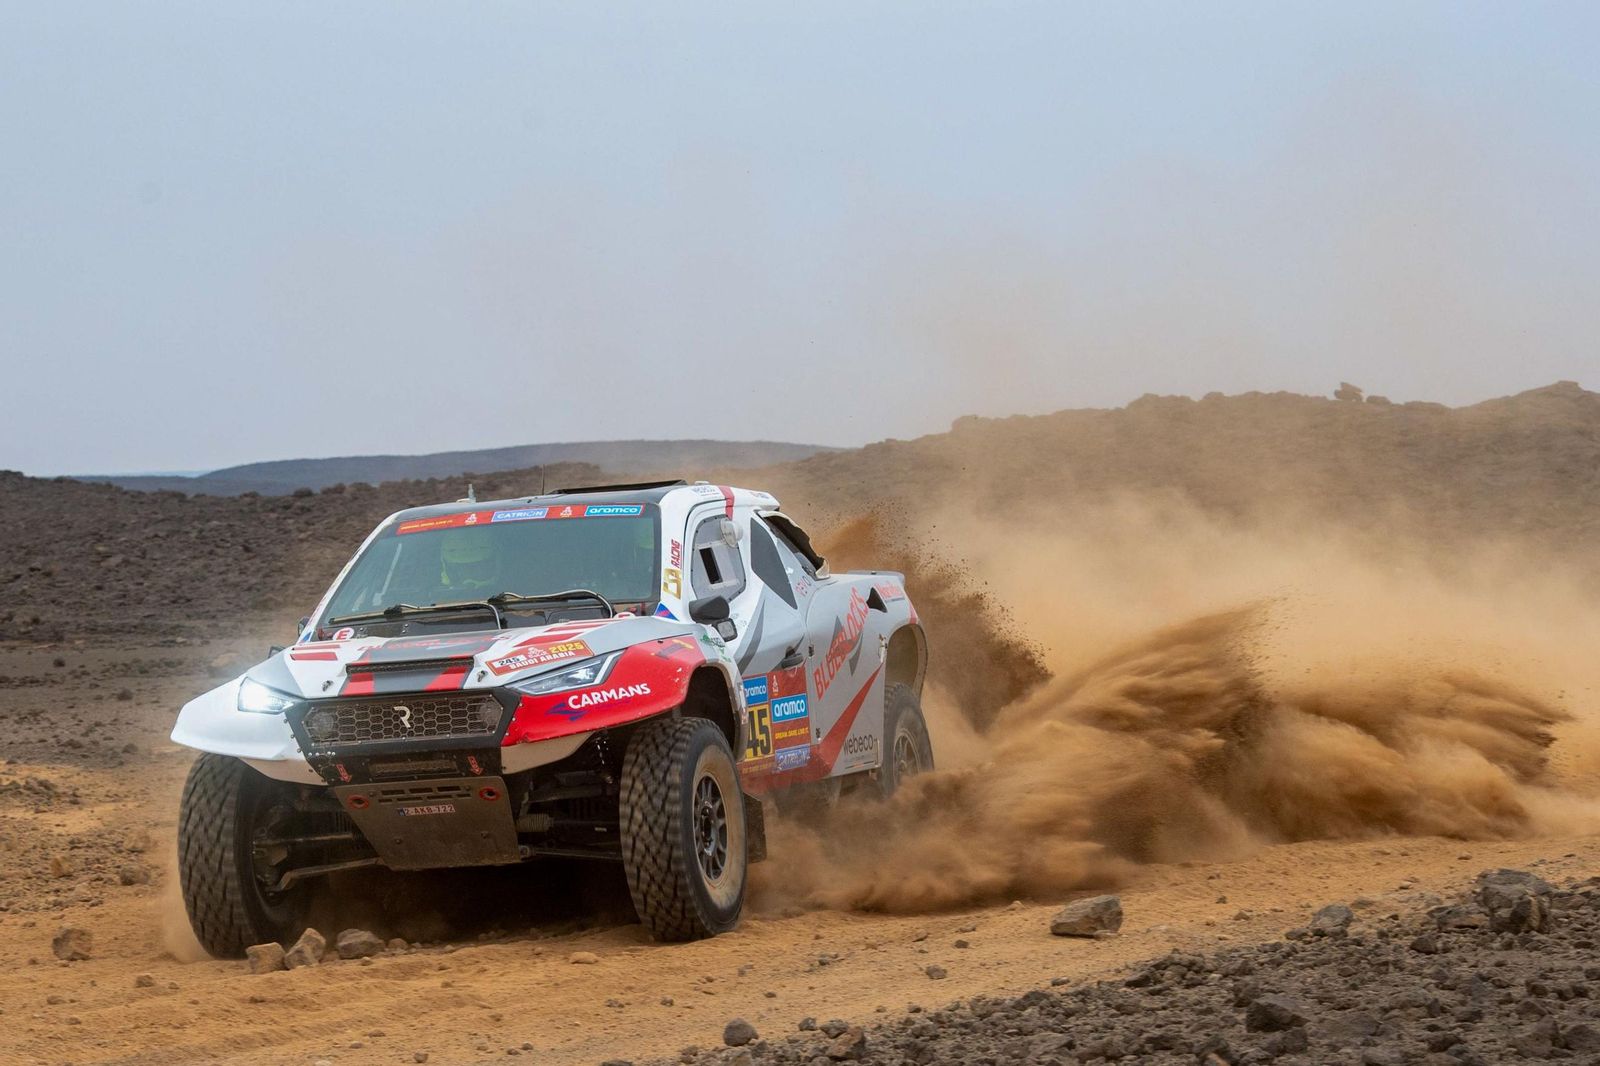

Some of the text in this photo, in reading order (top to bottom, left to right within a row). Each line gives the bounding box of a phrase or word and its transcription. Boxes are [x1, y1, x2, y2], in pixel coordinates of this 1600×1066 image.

[497, 511, 544, 519] CATRION
[670, 539, 681, 568] RACING
[548, 643, 584, 654] 2025
[499, 657, 520, 666] 245
[508, 659, 538, 670] SAUDI
[540, 651, 576, 662] ARABIA
[568, 683, 651, 709] CARMANS
[774, 699, 806, 718] aramco
[844, 734, 874, 756] webeco
